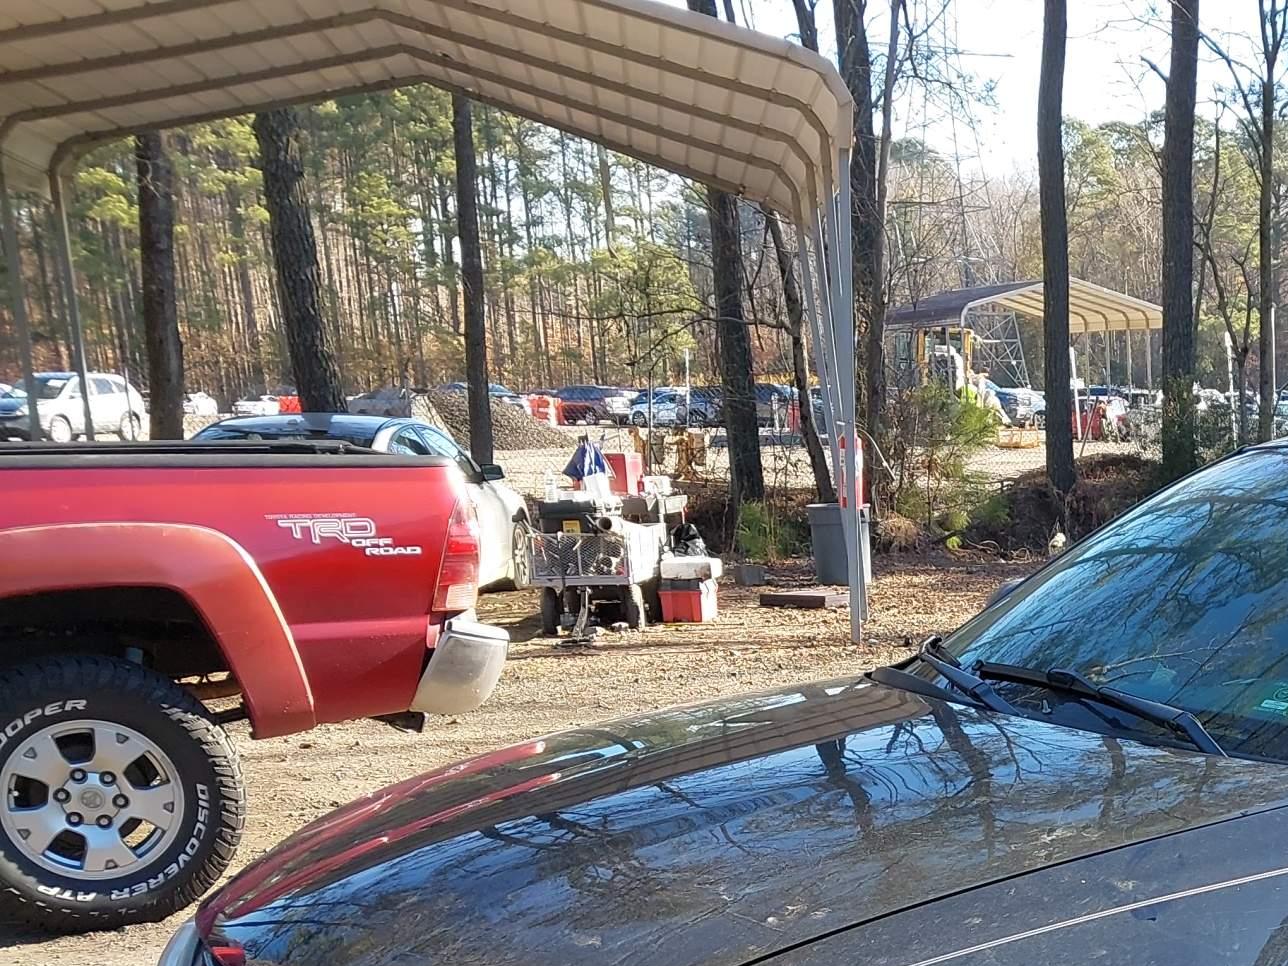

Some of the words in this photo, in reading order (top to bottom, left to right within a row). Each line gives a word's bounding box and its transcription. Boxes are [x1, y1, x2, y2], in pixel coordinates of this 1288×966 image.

[277, 517, 377, 544] TRD
[351, 537, 394, 547] OFF
[365, 546, 423, 556] ROAD
[109, 783, 210, 901] DISCOVERER
